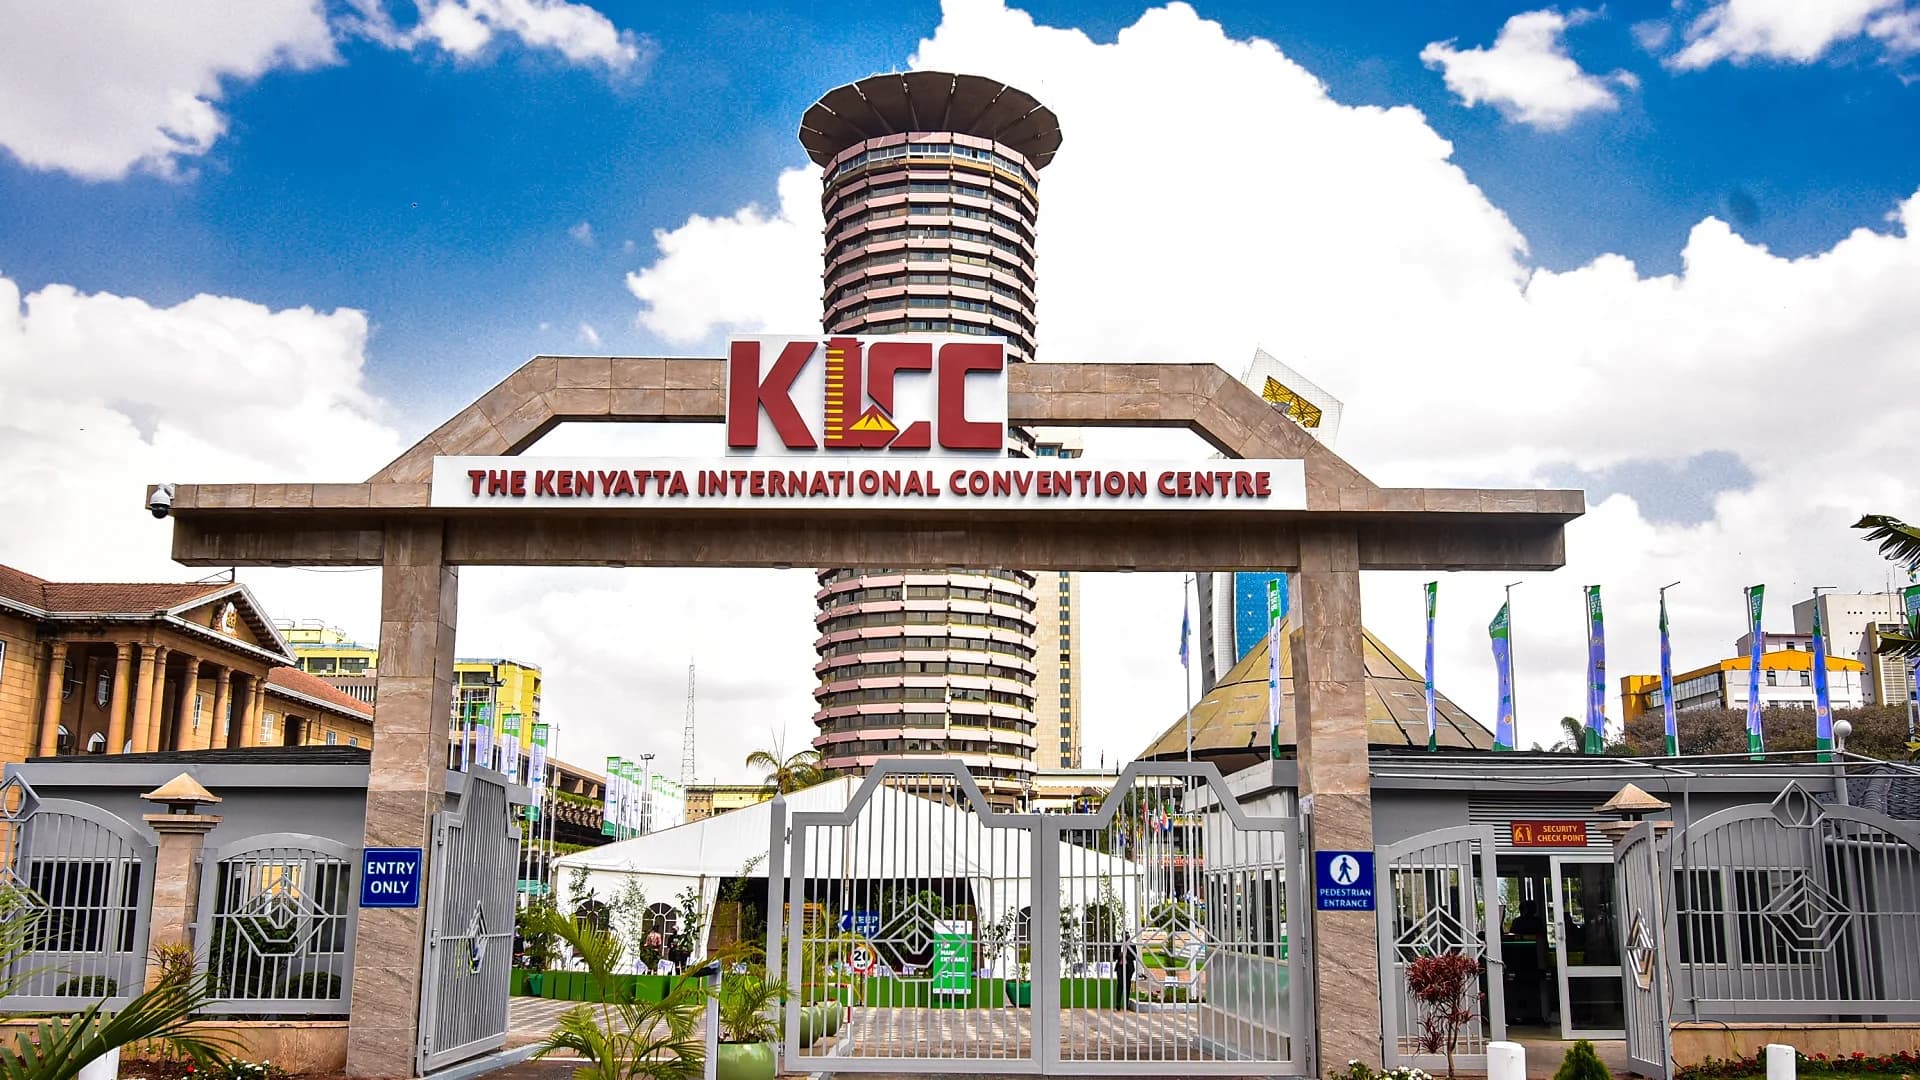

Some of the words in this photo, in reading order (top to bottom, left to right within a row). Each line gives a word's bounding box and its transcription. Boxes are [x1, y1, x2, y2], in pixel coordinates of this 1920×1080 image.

[470, 470, 525, 495] THE
[536, 470, 688, 495] KENYATTA
[699, 470, 940, 495] INTERNATIONAL
[950, 470, 1146, 495] CONVENTION
[1158, 471, 1270, 496] CENTRE
[1542, 825, 1577, 833] SECURITY
[1537, 834, 1561, 842] CHECK
[1562, 834, 1585, 842] POINT
[367, 861, 416, 875] ENTRY
[370, 881, 410, 894] ONLY
[1319, 888, 1371, 897] PEDESTRIAN
[1323, 899, 1368, 908] ENTRANCE
